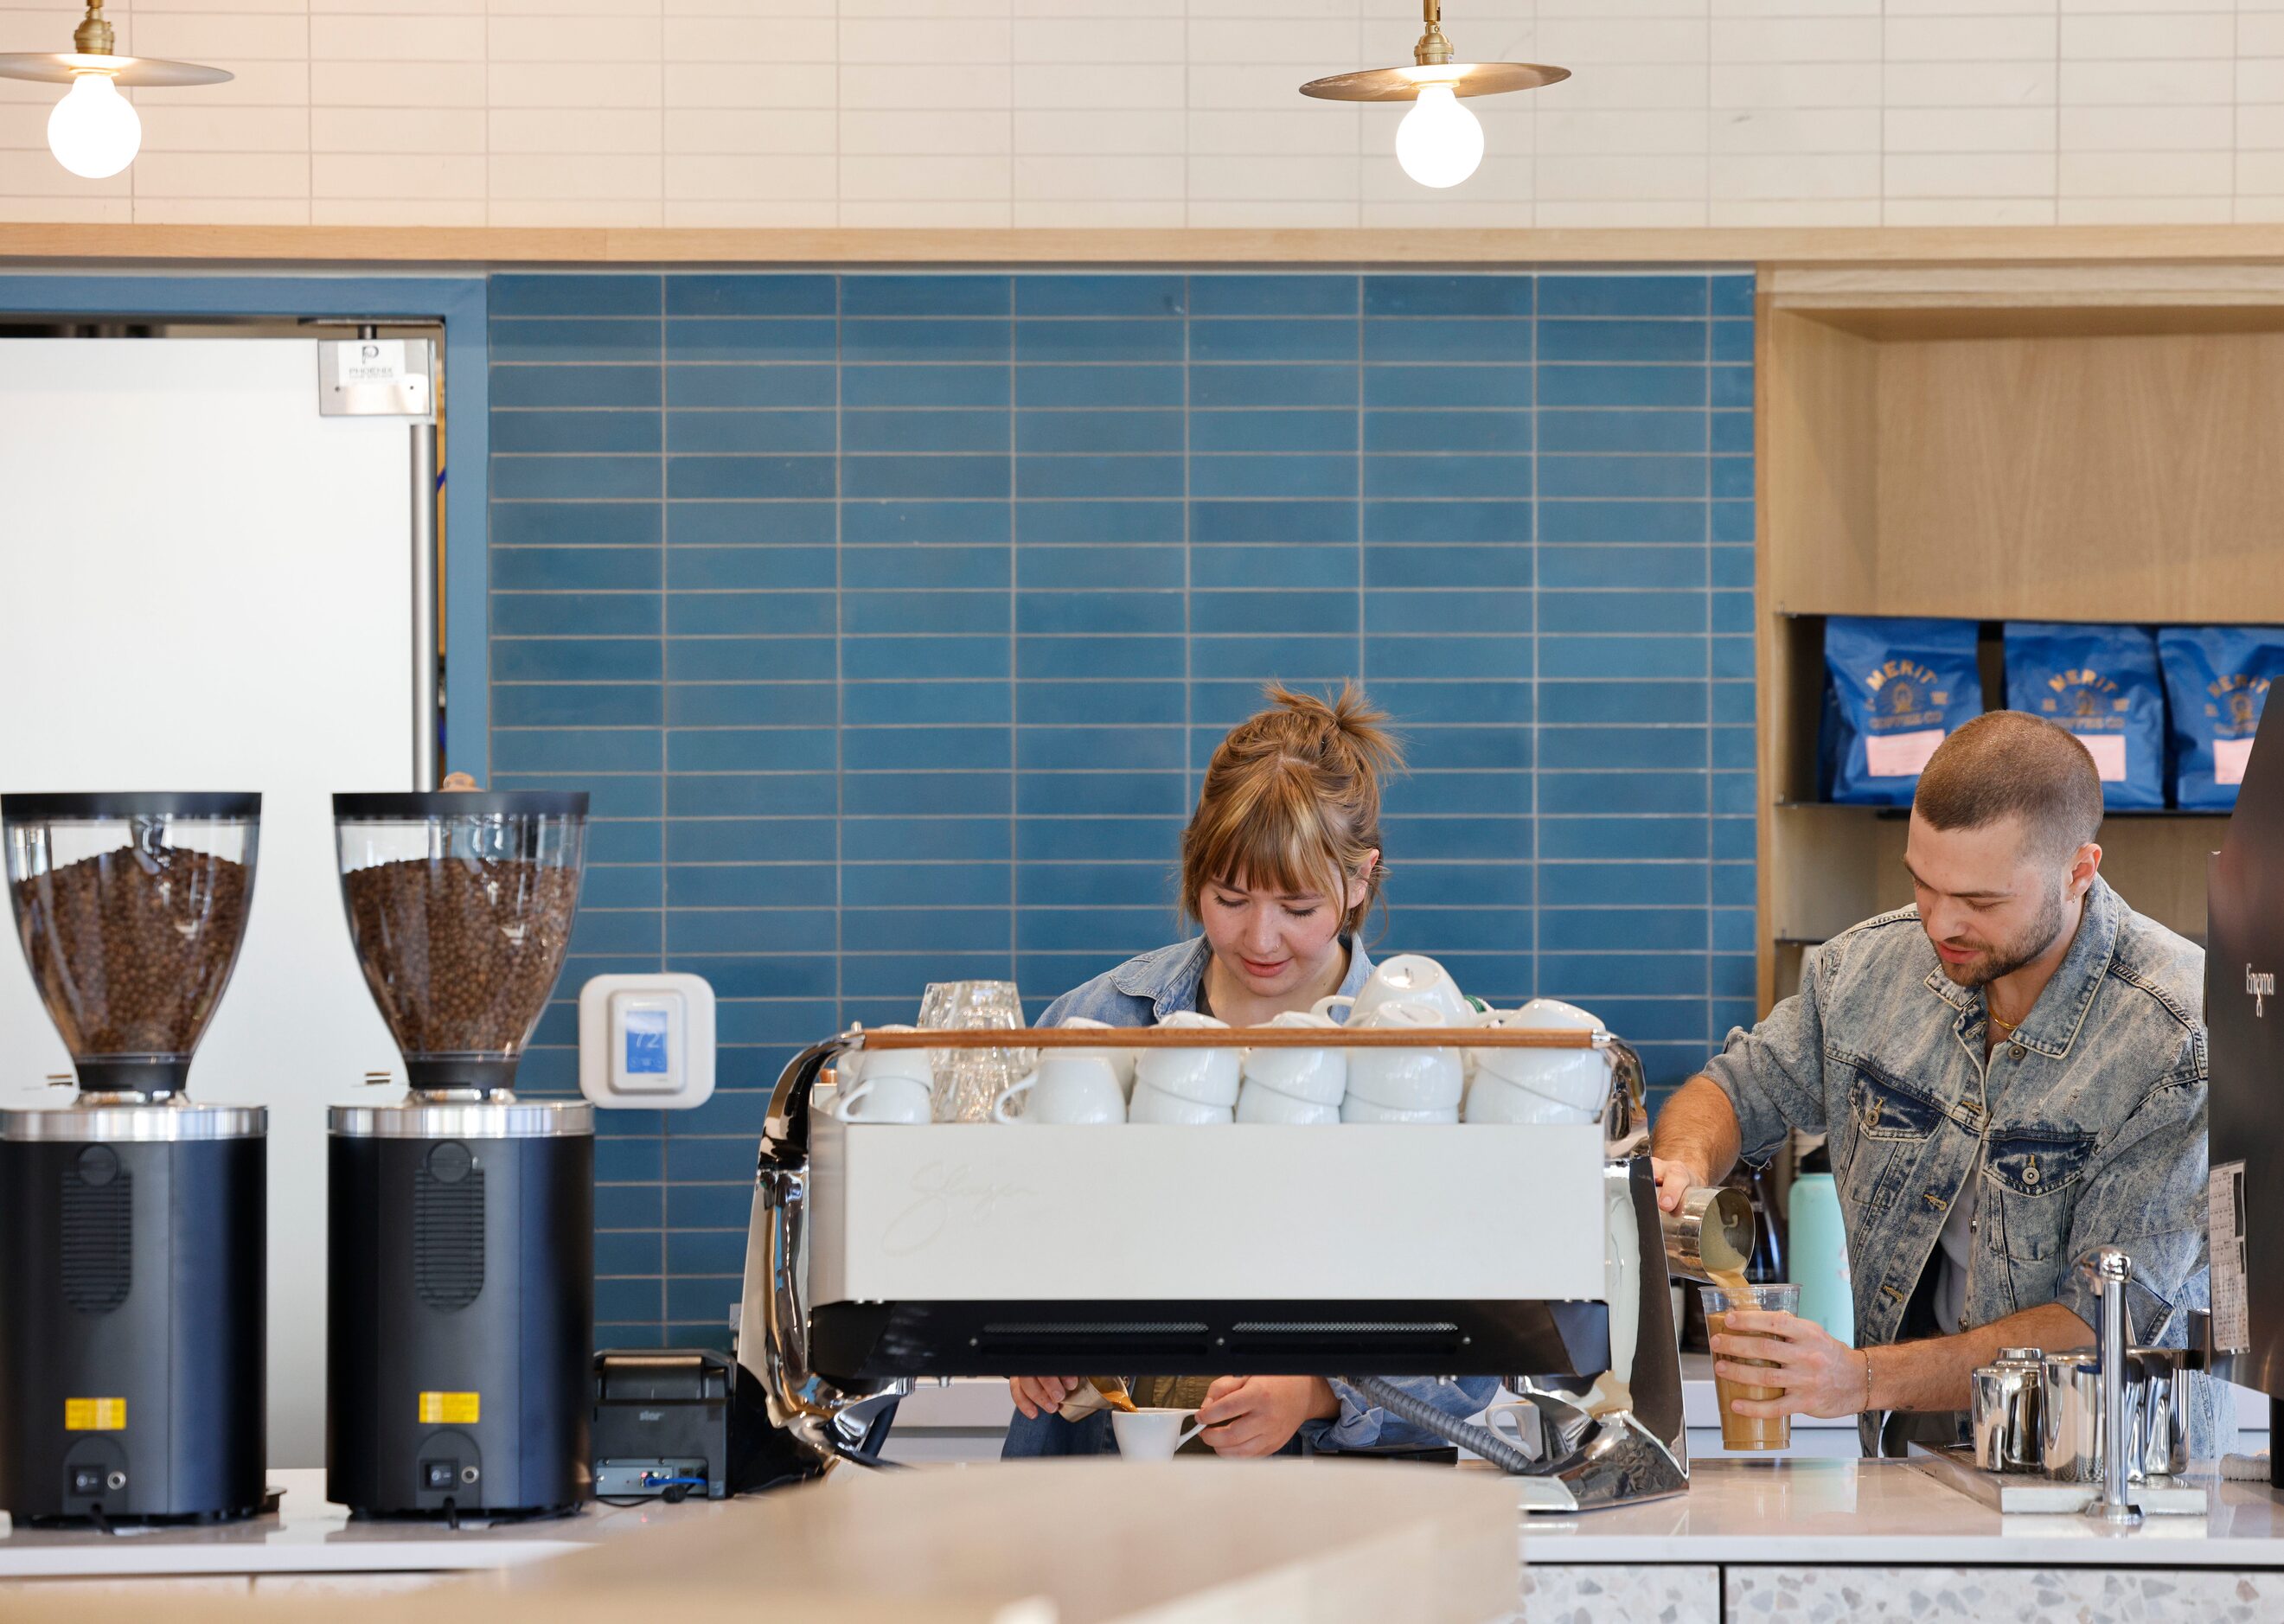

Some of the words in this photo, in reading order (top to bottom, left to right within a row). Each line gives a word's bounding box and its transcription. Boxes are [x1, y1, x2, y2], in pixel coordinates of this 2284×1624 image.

[1865, 658, 1938, 692] MERIT
[2048, 668, 2118, 694] MERIT
[635, 1030, 660, 1048] 72
